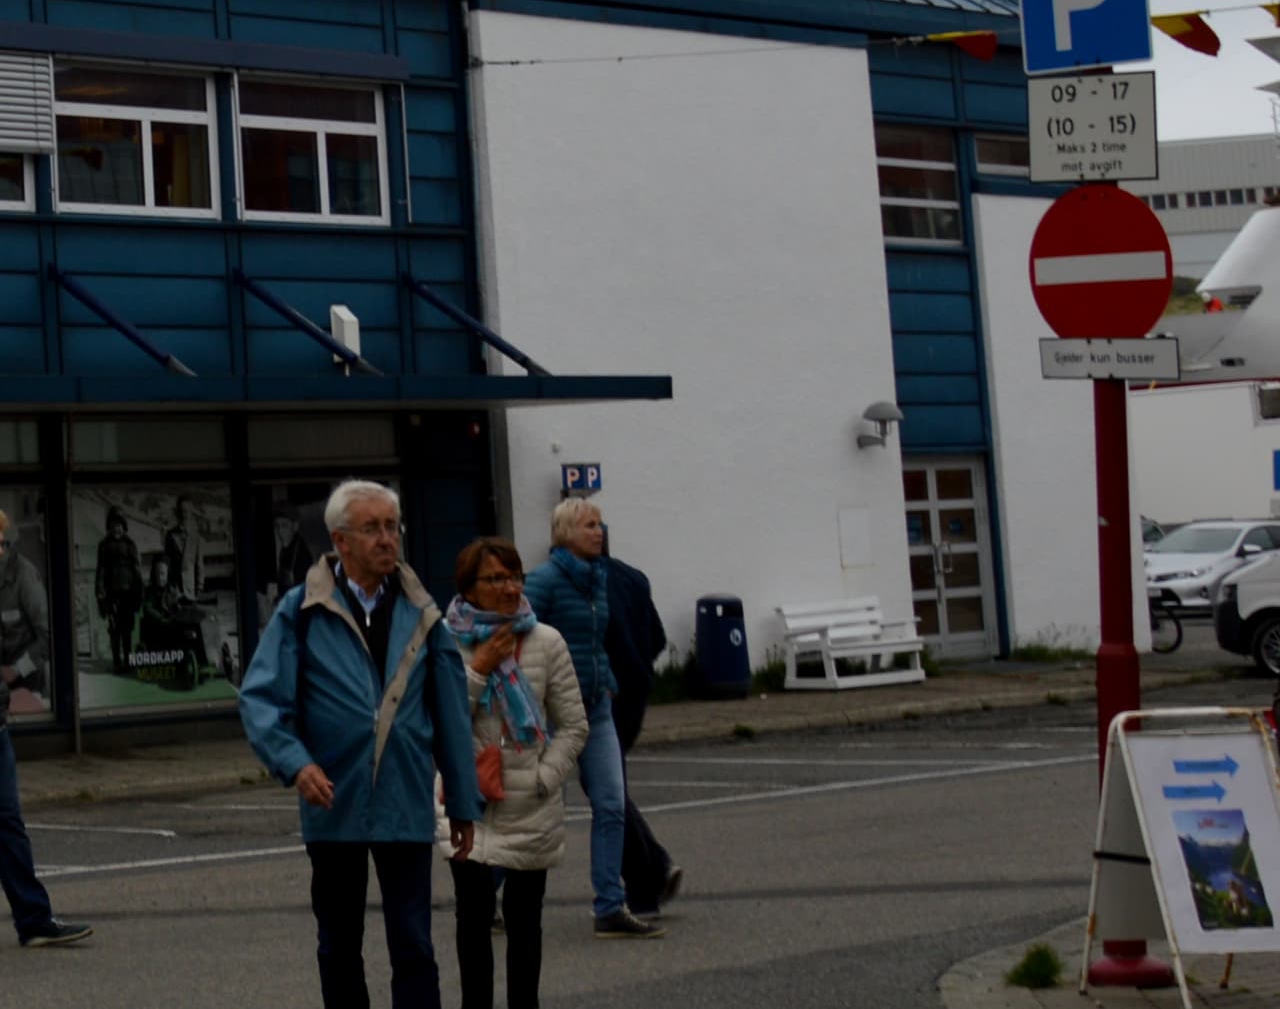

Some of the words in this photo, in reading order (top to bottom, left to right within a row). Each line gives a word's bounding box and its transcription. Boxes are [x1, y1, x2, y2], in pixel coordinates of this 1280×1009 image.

[1051, 84, 1077, 103] 09
[1111, 81, 1129, 100] 17
[1047, 117, 1075, 138] (10
[1108, 112, 1137, 135] 15)
[1057, 143, 1085, 154] Maks
[1090, 141, 1097, 153] 2
[1102, 141, 1127, 152] time
[1089, 159, 1123, 173] avgift
[1090, 352, 1111, 363] kun
[1116, 352, 1155, 364] busser
[566, 467, 581, 488] P
[587, 466, 598, 488] P
[128, 650, 184, 666] NORDKAPP
